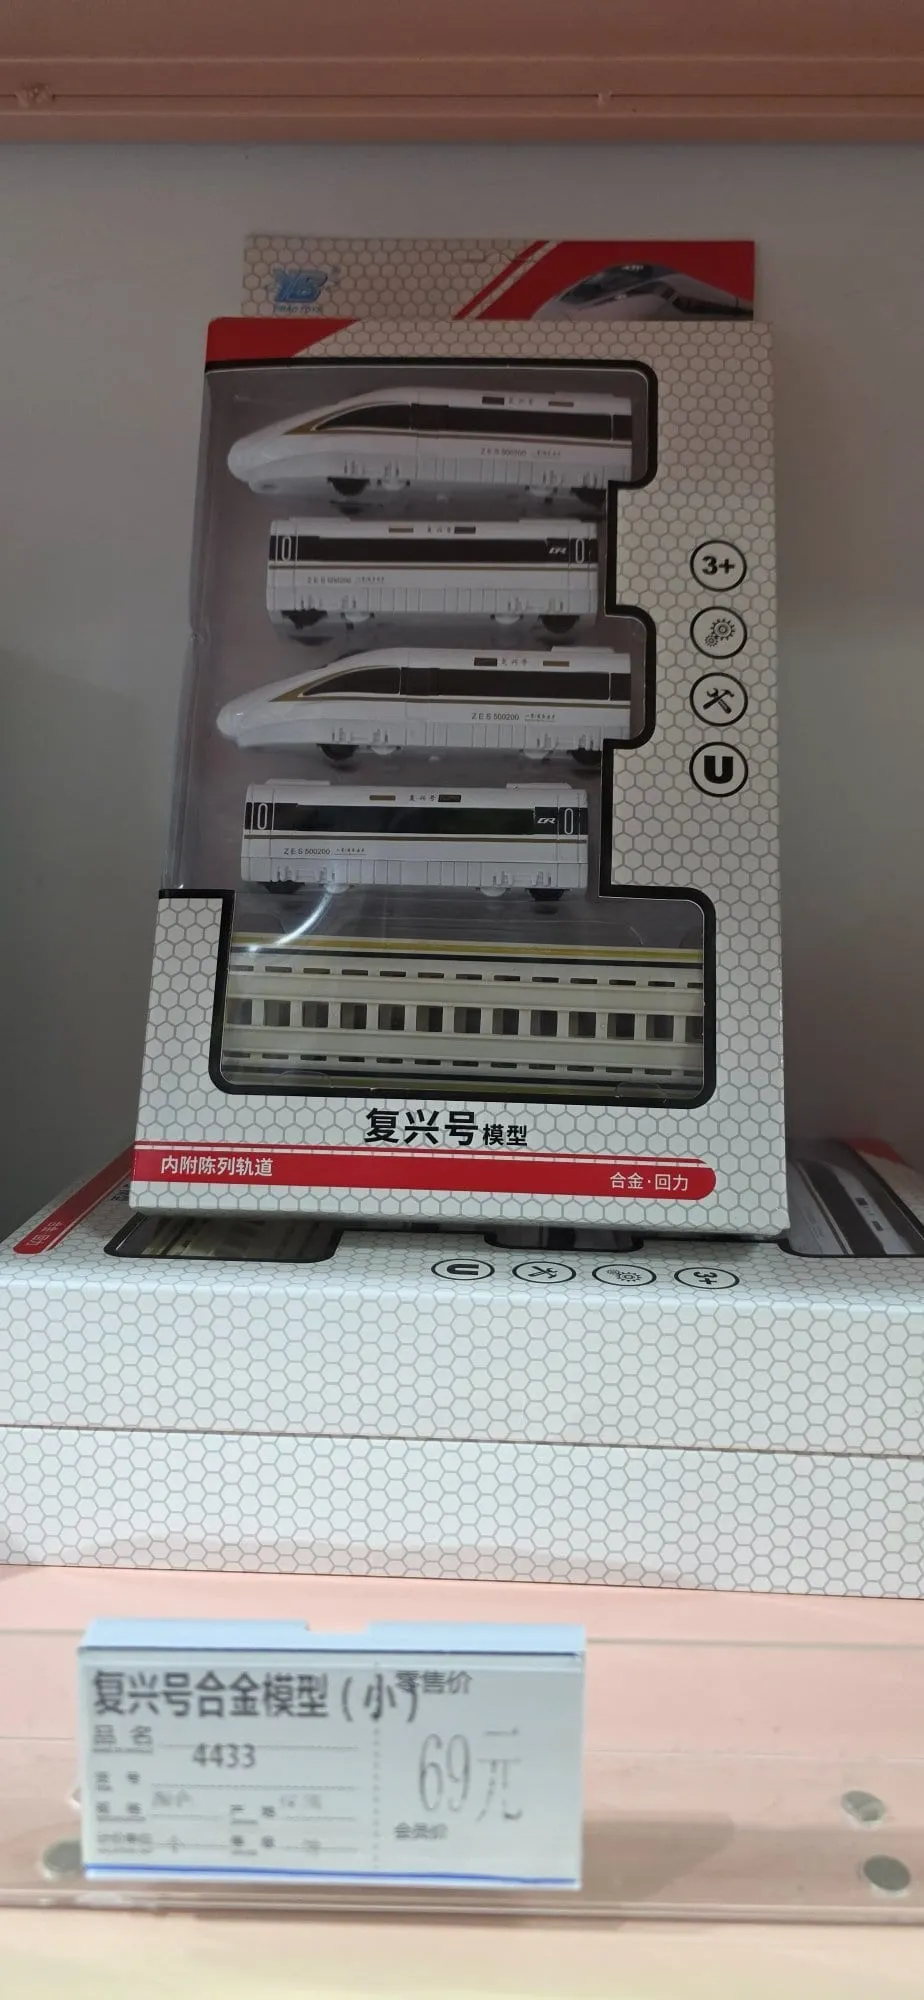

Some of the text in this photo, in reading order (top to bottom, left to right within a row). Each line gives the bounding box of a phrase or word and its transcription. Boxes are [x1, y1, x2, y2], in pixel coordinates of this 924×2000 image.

[701, 555, 736, 576] 3+
[160, 1155, 274, 1177] 内附陈列轨道
[192, 1742, 257, 1769] 4433
